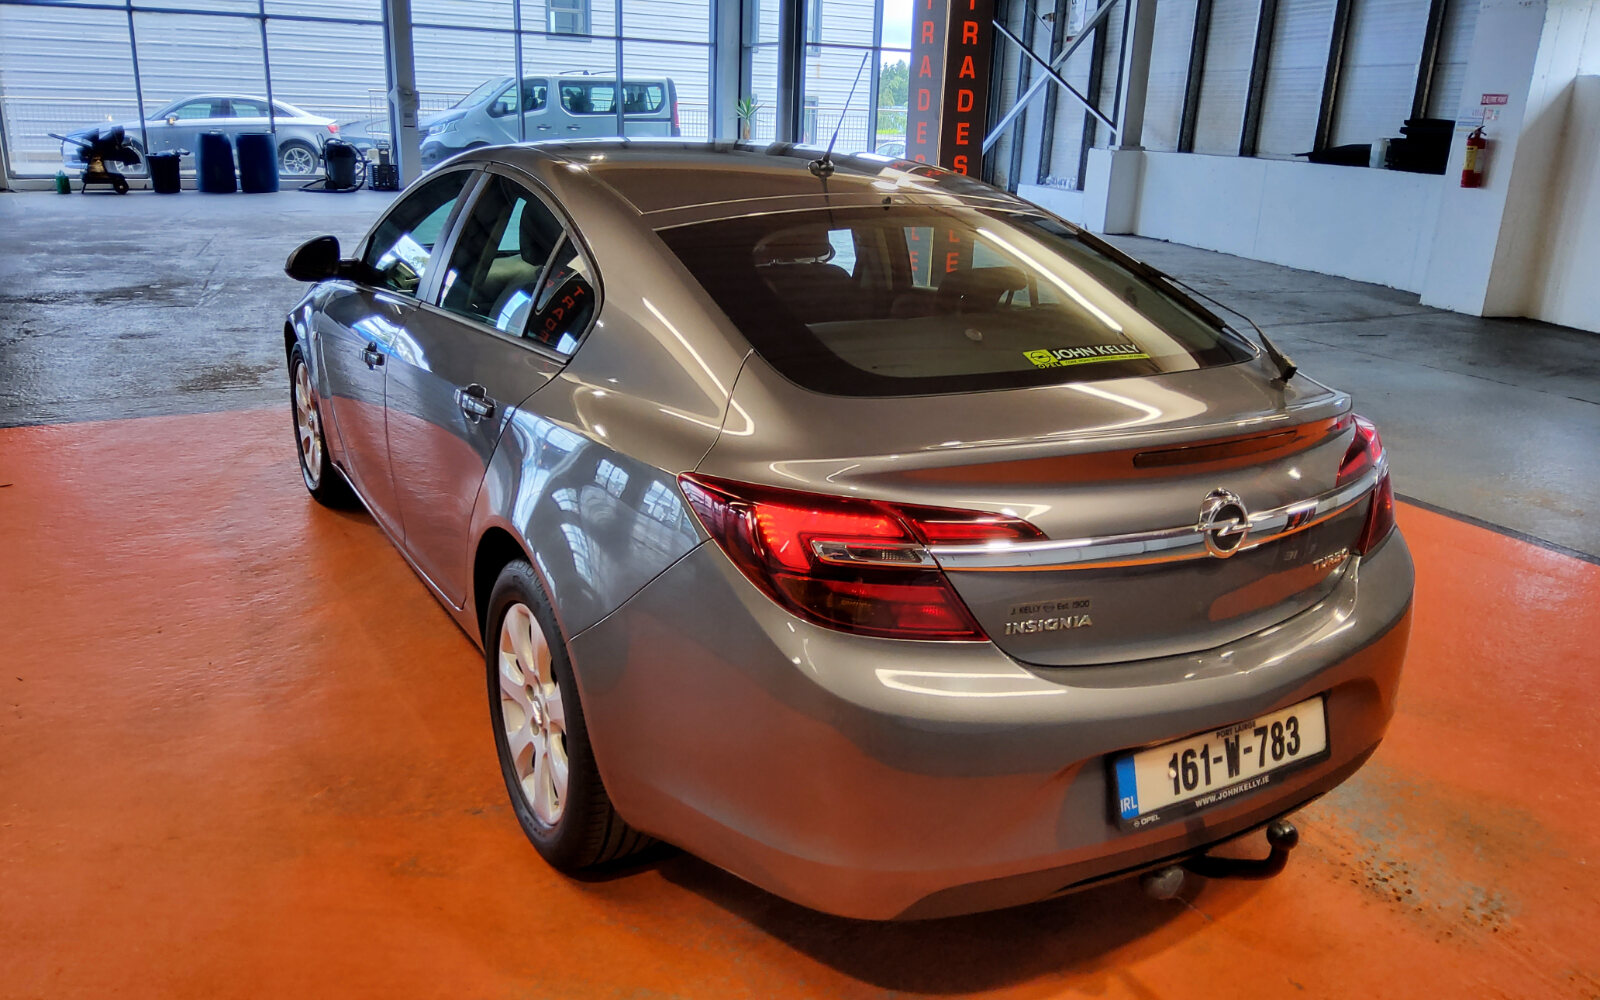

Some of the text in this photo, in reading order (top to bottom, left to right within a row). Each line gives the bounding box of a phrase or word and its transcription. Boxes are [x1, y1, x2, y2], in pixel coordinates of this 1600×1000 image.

[1052, 346, 1095, 360] JOHN
[1095, 344, 1139, 355] KELLY
[1038, 361, 1062, 369] OPEL
[1019, 605, 1041, 614] KELLY
[1005, 614, 1093, 635] INSIGNIA
[1216, 727, 1233, 739] PORT
[1168, 716, 1301, 796] 161-W-783
[1195, 775, 1270, 808] WWW.JOHNKELLY.IE
[1120, 796, 1138, 813] IRL
[1140, 814, 1160, 825] OPEL
